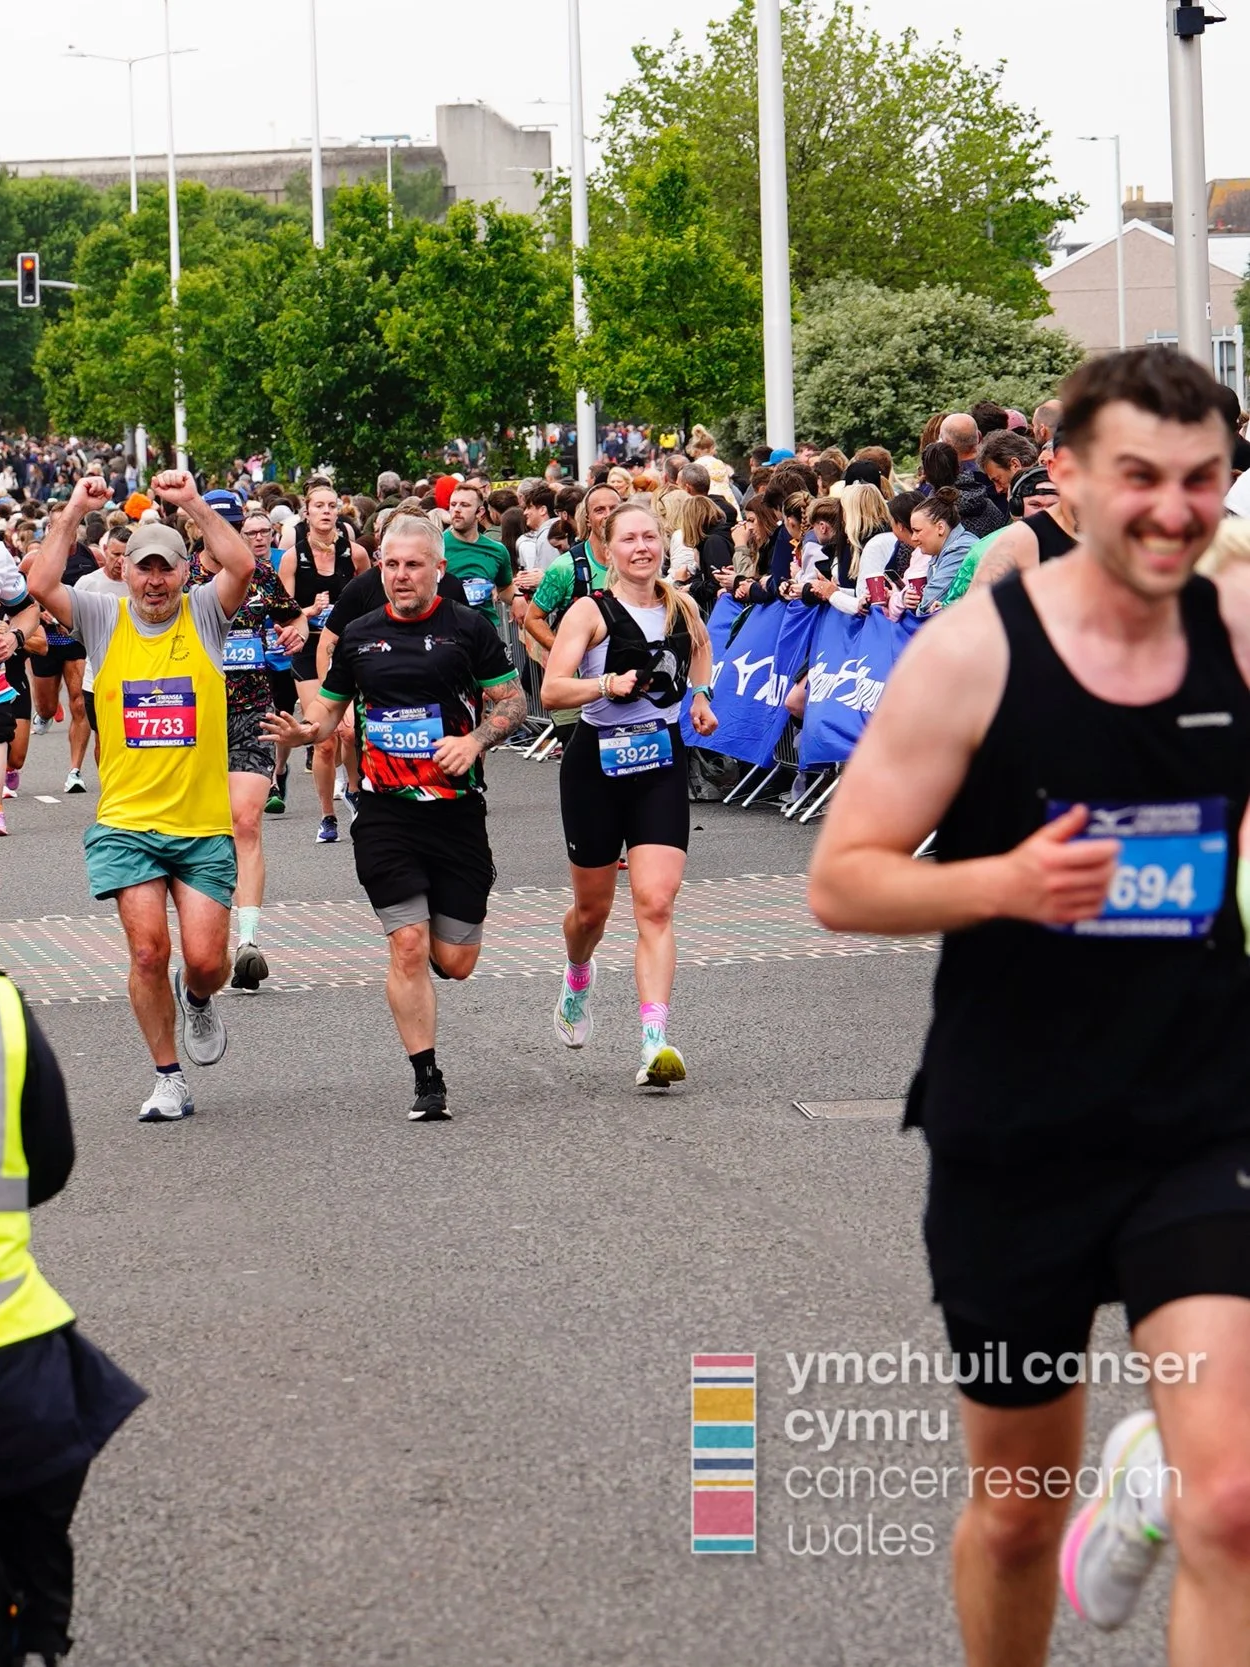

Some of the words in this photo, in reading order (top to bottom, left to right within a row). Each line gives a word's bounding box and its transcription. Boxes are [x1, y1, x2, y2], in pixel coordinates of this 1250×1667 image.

[125, 710, 147, 718] JOHN
[138, 717, 184, 736] 7733
[368, 724, 393, 732] DAVID
[382, 731, 430, 749] 3305
[615, 743, 660, 764] 3922
[1107, 863, 1197, 912] 694
